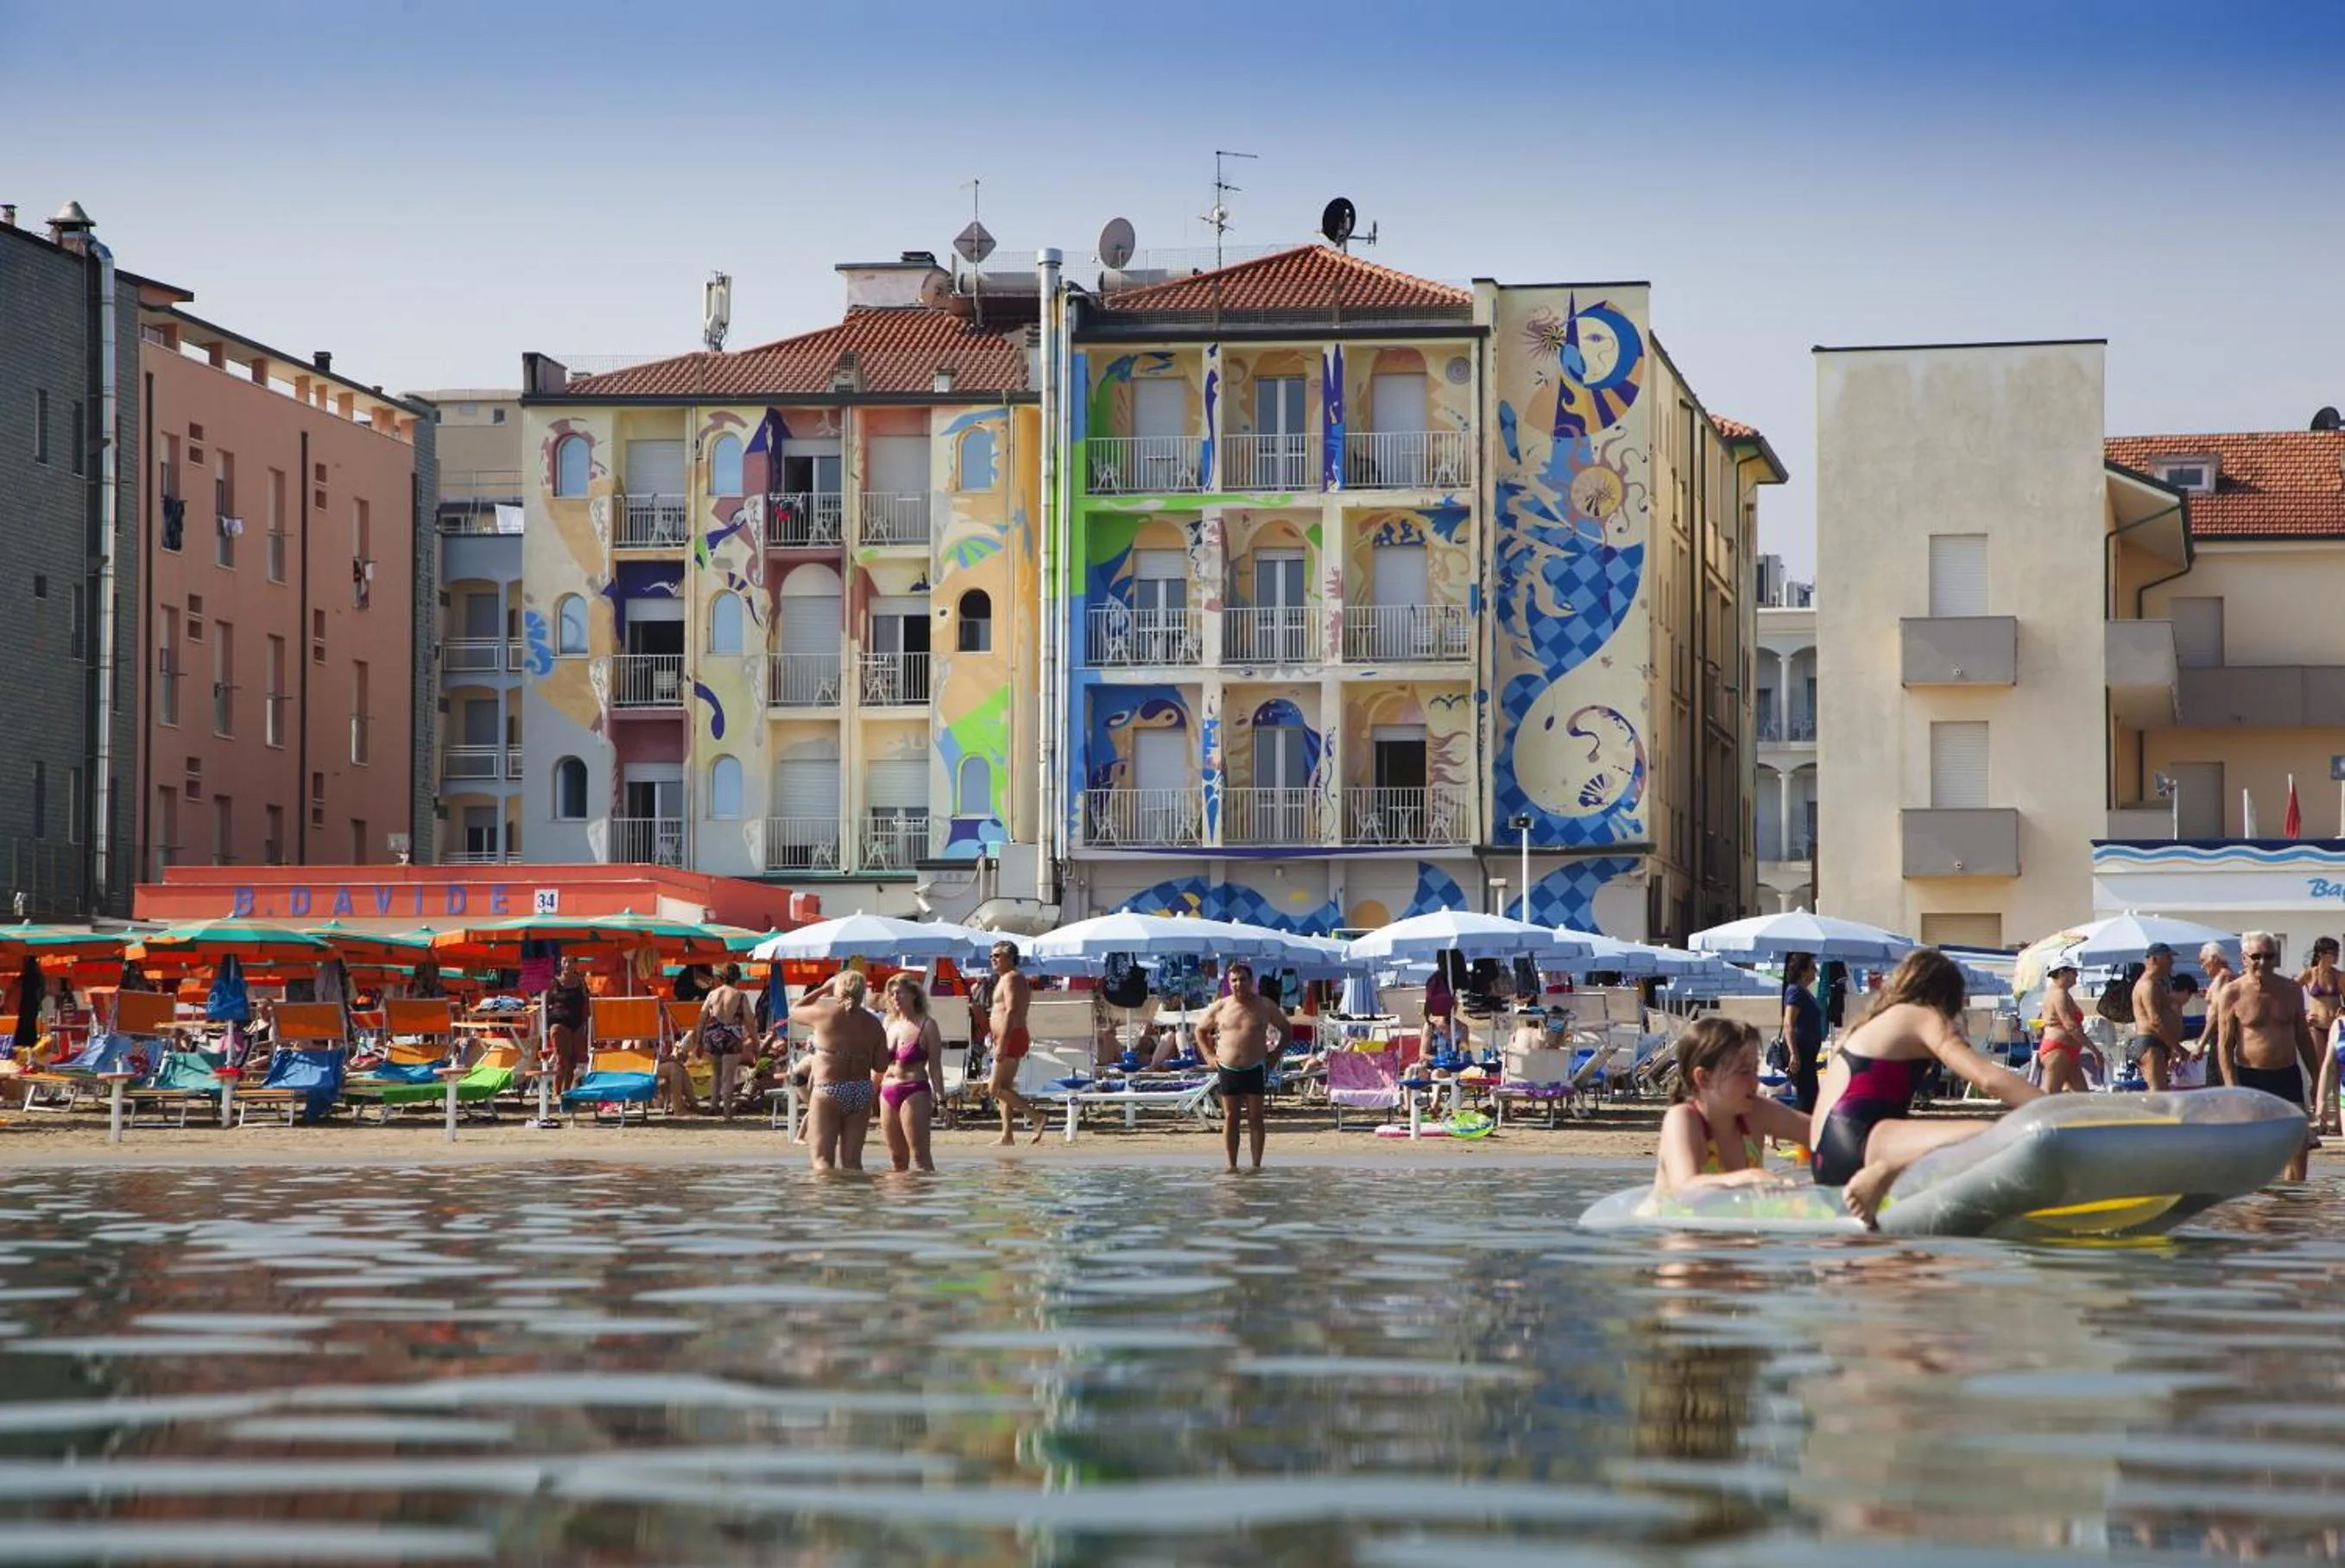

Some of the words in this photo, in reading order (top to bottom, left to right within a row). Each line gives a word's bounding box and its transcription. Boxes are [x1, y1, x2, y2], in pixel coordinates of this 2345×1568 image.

[290, 885, 509, 916] DAVIDE
[537, 893, 555, 909] 34
[2307, 877, 2345, 902] Ba
